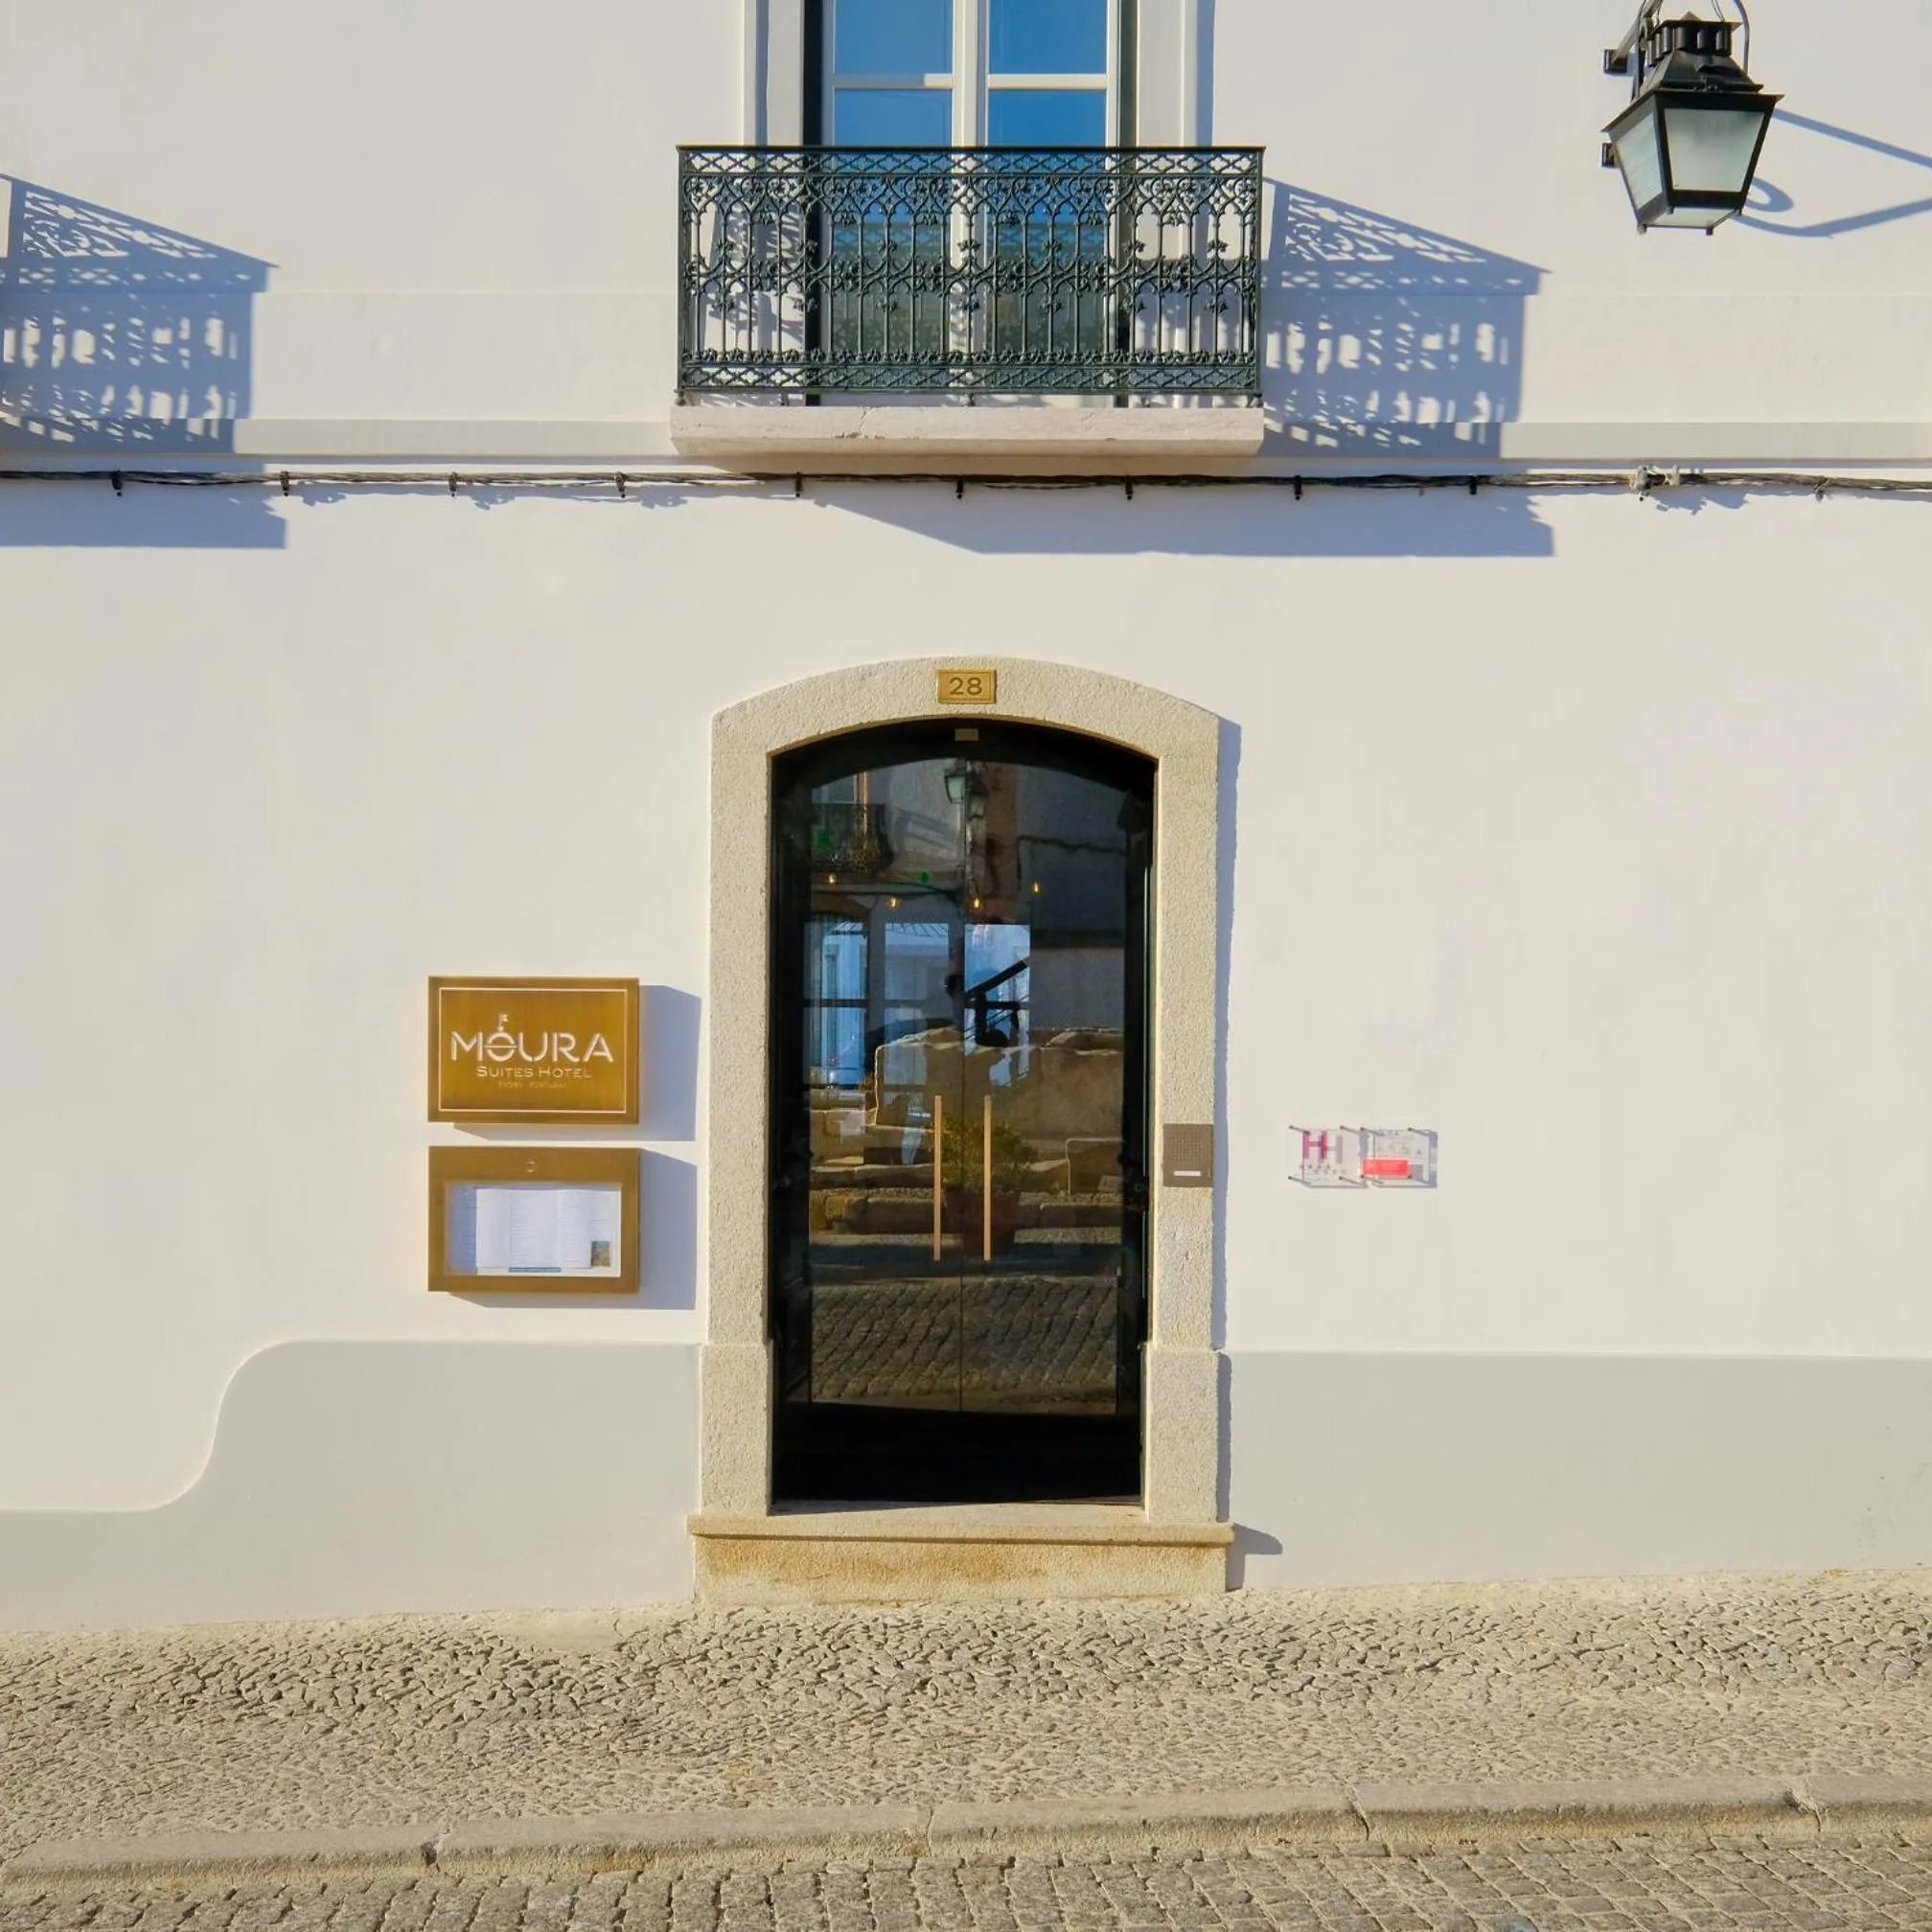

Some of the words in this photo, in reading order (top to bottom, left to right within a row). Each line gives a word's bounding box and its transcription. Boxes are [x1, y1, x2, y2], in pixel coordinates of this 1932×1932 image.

[949, 677, 982, 696] 28
[449, 1027, 614, 1063] MOURA
[475, 1066, 534, 1078] SUITES
[538, 1067, 592, 1079] HOTEL
[1302, 1130, 1327, 1159] H
